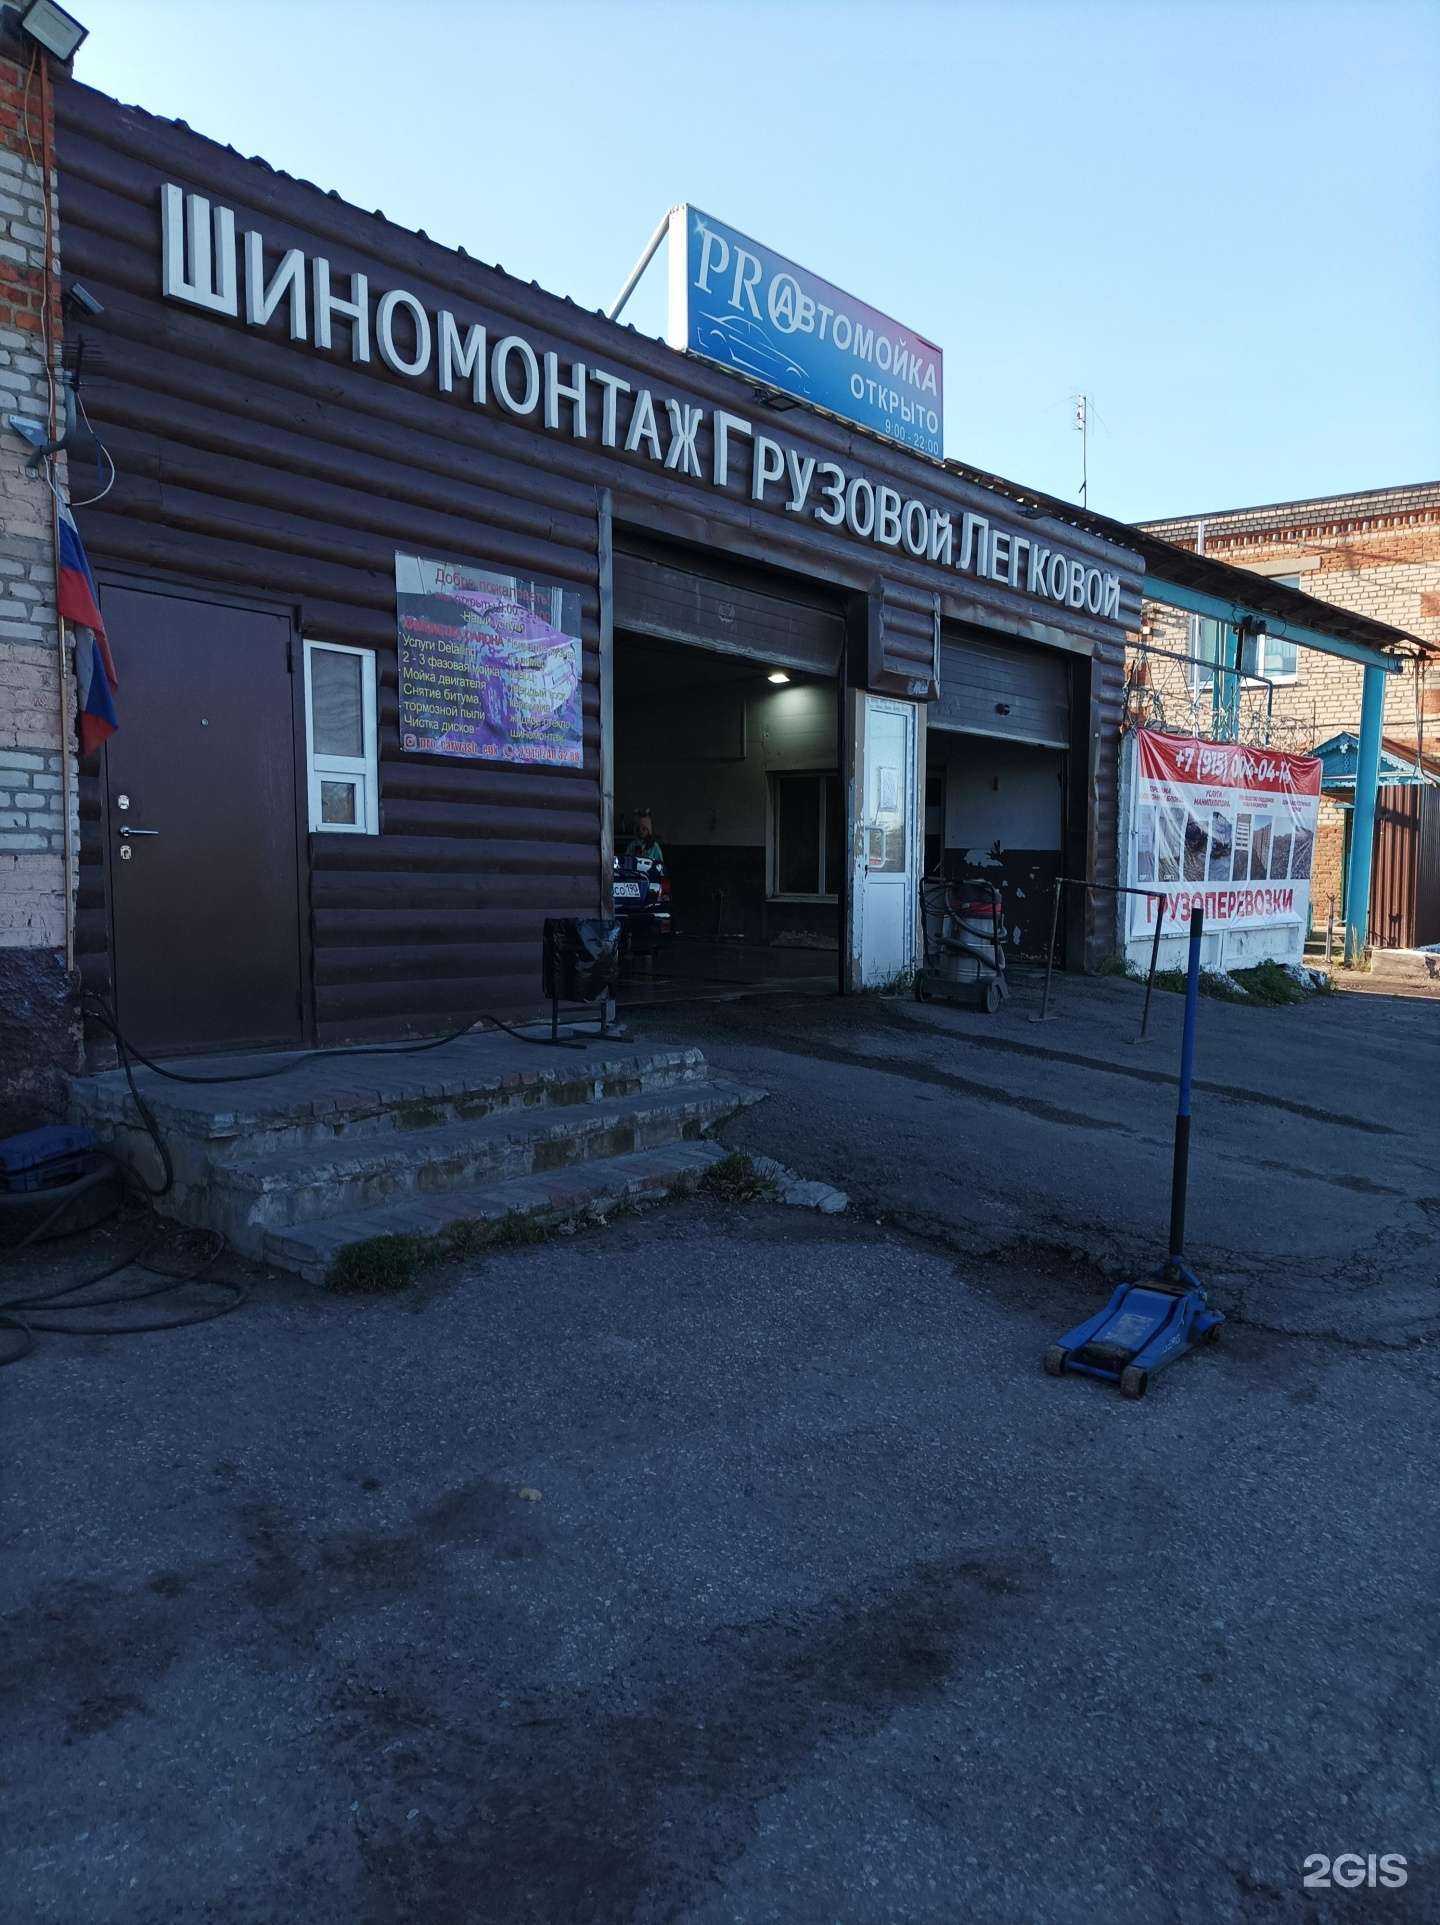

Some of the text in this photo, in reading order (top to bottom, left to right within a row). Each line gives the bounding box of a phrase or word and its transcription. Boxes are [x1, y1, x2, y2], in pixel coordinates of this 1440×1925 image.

[161, 183, 702, 478] ШИНОМОНТАЖ
[850, 373, 939, 434] ОТКРЫТО
[885, 418, 906, 440] 9:00
[913, 432, 939, 456] 22:00
[403, 633, 435, 651] Услуги
[402, 651, 410, 663] 2
[419, 653, 426, 665] 3
[428, 656, 470, 673] фазовая
[403, 666, 487, 690] Мойка двигателя
[403, 682, 441, 699] Снятие
[403, 701, 486, 720] тормозной пыли
[404, 714, 475, 733] Чистка дисков
[1175, 747, 1195, 773] +7
